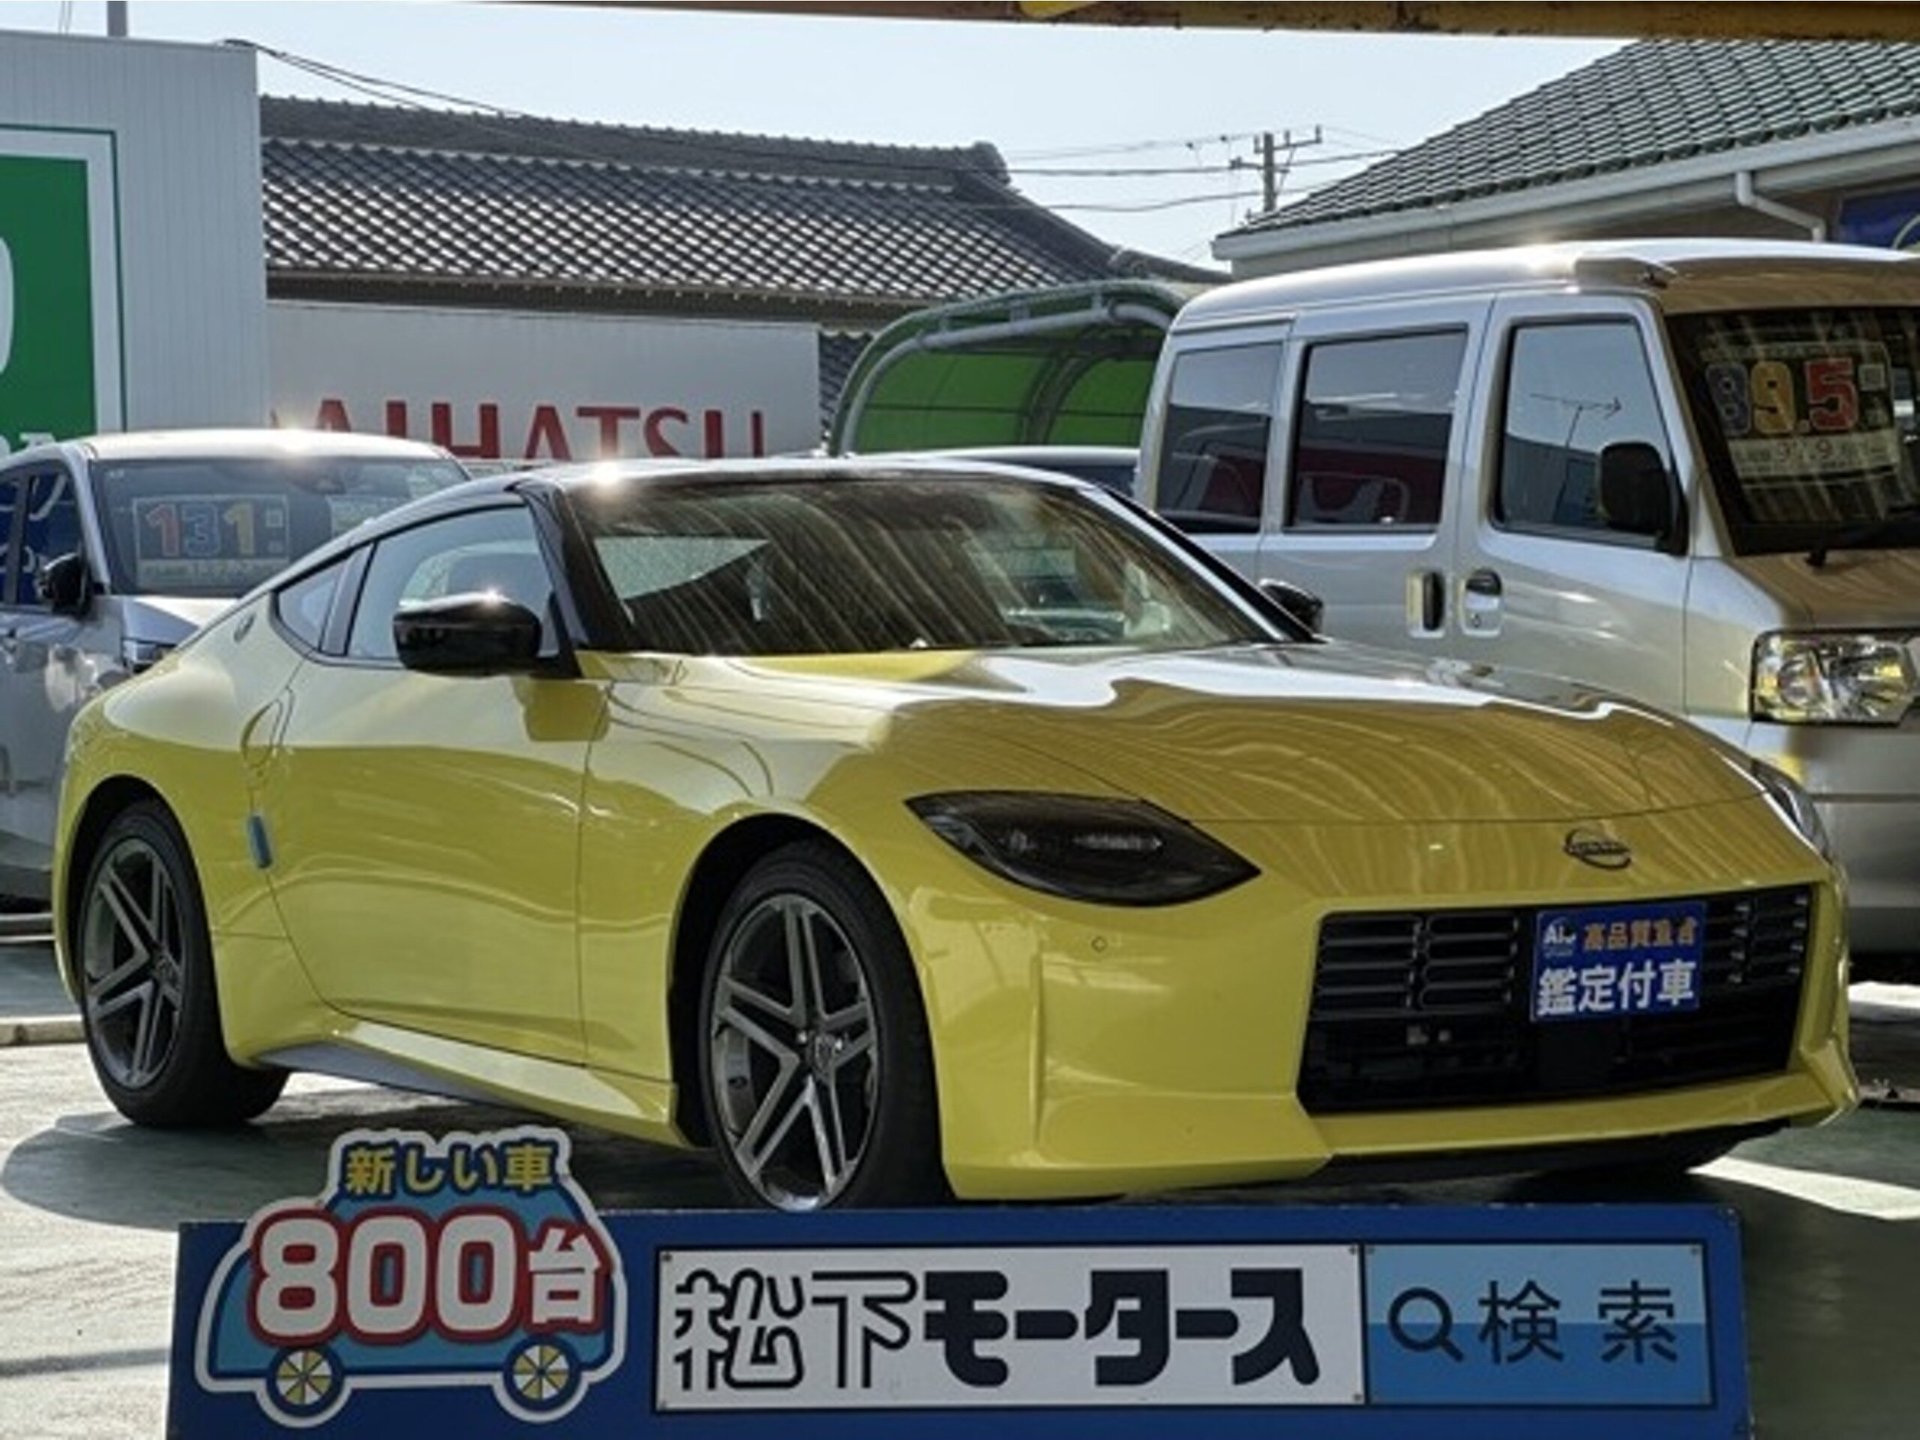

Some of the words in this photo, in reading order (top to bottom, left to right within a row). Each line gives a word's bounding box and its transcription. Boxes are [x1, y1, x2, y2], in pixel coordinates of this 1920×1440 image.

[1536, 958, 1697, 1017] 鑑定付車
[346, 1142, 557, 1195] 新しい車
[254, 1213, 602, 1337] 800台
[673, 1267, 1321, 1390] 松下モータース
[1477, 1279, 1679, 1364] 検索
